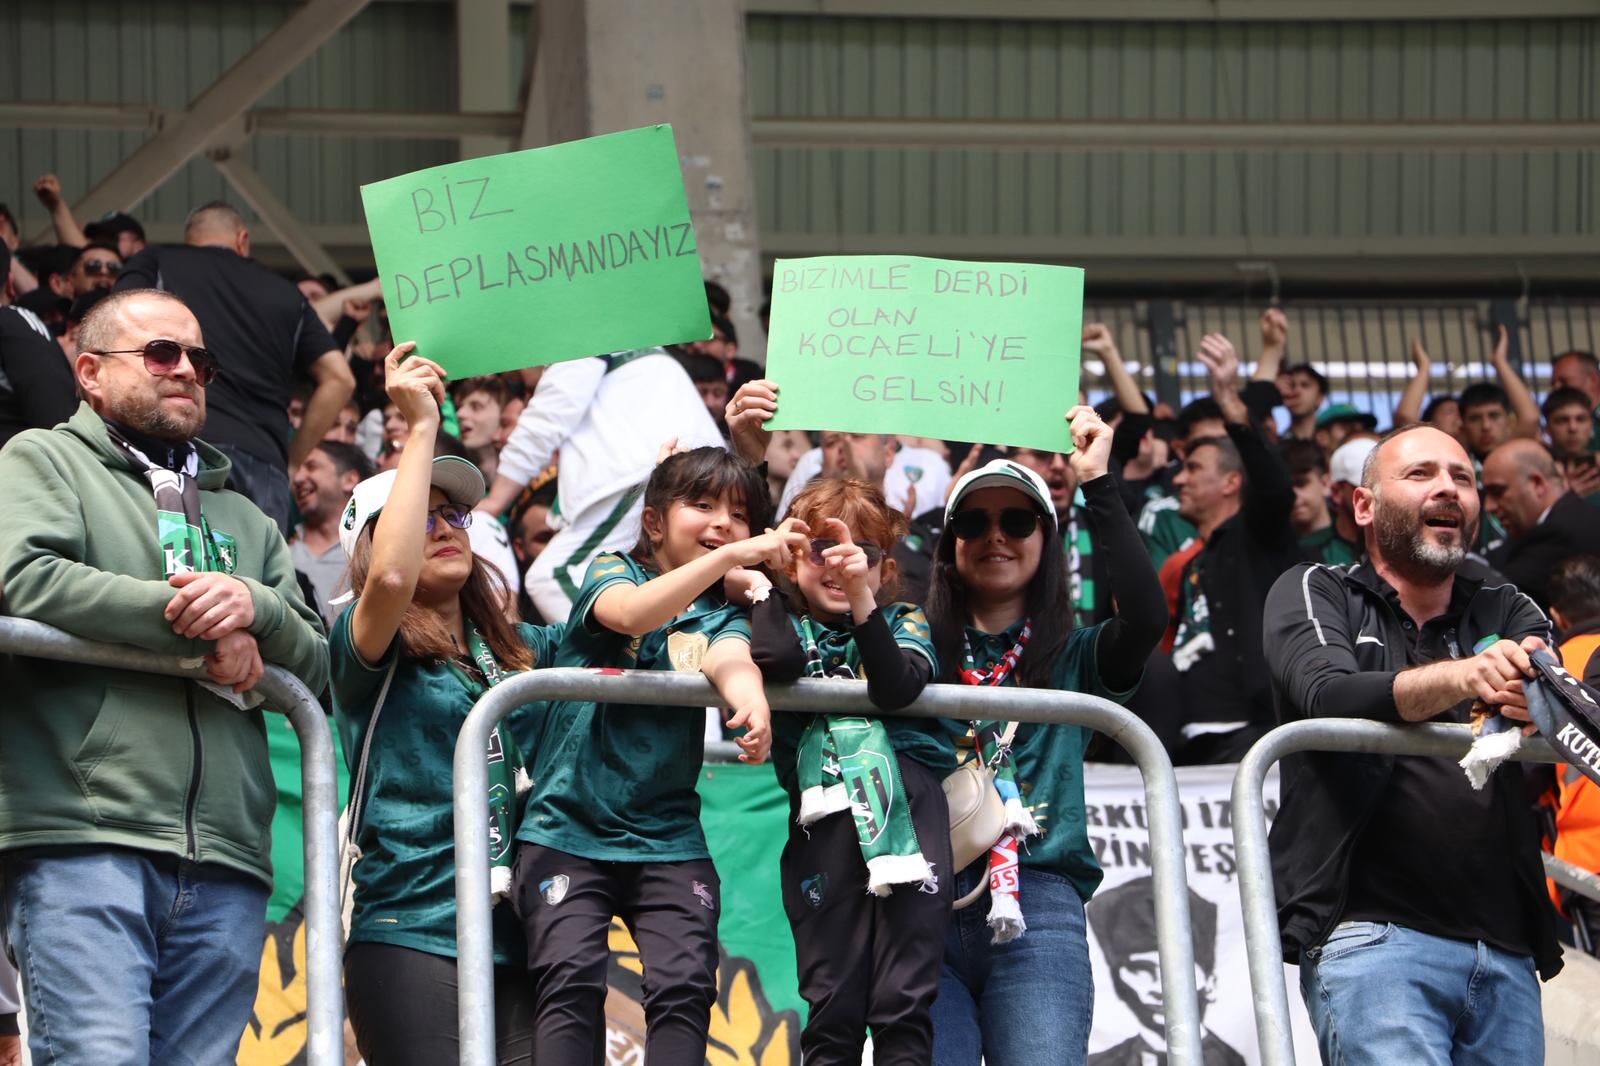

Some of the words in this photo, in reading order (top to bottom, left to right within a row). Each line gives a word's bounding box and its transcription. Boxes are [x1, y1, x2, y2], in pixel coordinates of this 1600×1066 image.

[411, 175, 514, 235] BİZ
[394, 222, 697, 309] DEPLASMANDAYIZ
[828, 306, 917, 328] OLAN
